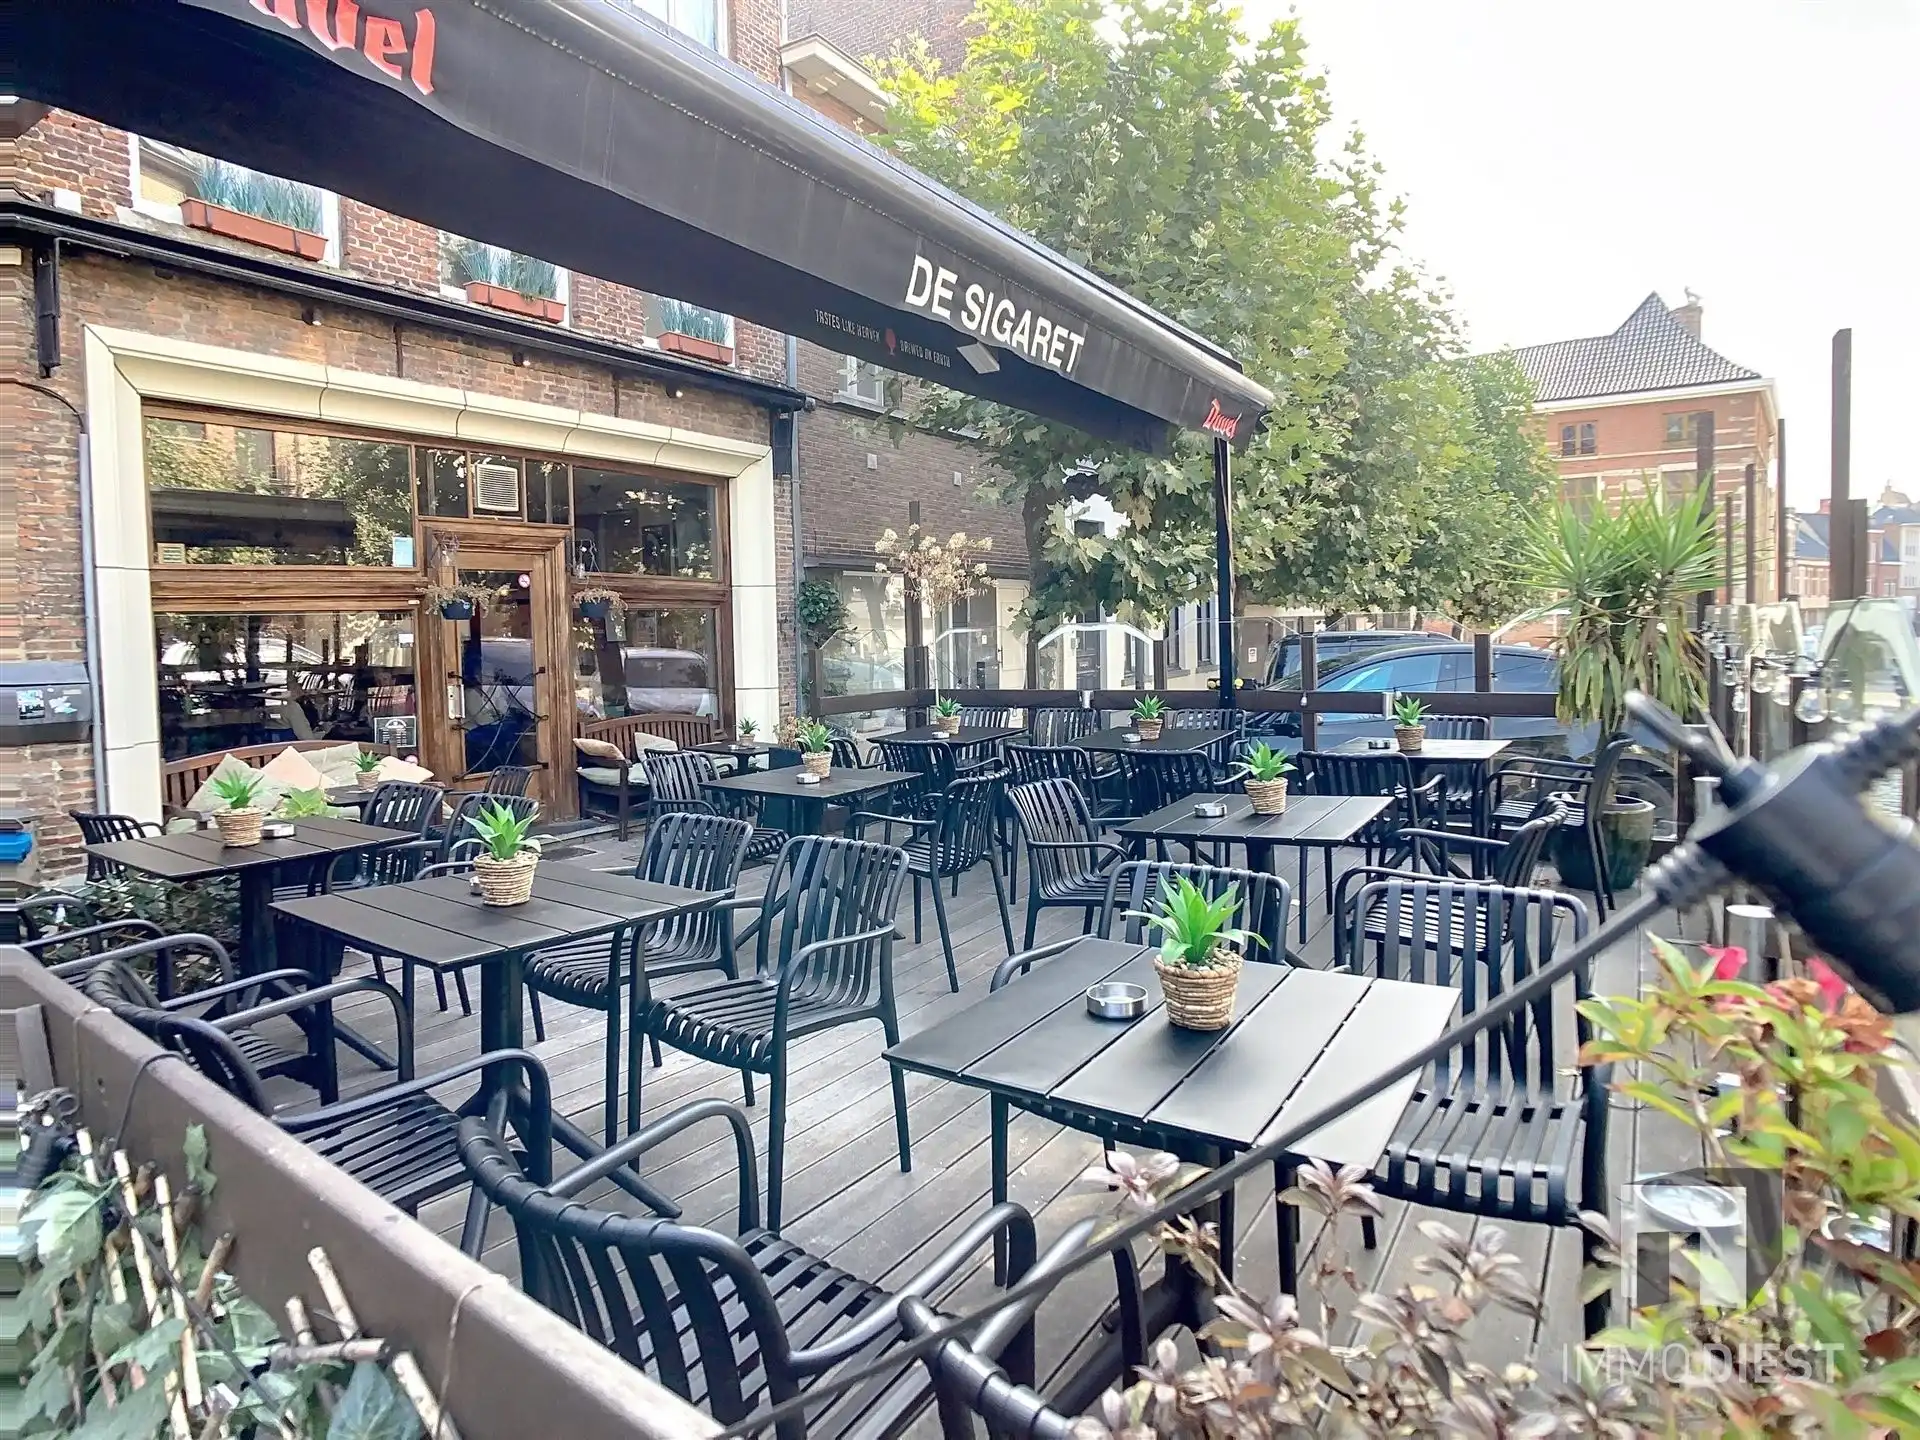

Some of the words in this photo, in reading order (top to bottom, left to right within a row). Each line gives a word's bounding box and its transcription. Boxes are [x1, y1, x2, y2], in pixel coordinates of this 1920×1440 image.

[815, 308, 841, 330] TASTES
[841, 317, 856, 336] LIKE
[905, 254, 958, 320] DE
[960, 283, 1085, 373] SIGARET
[1202, 398, 1243, 439] Duvel
